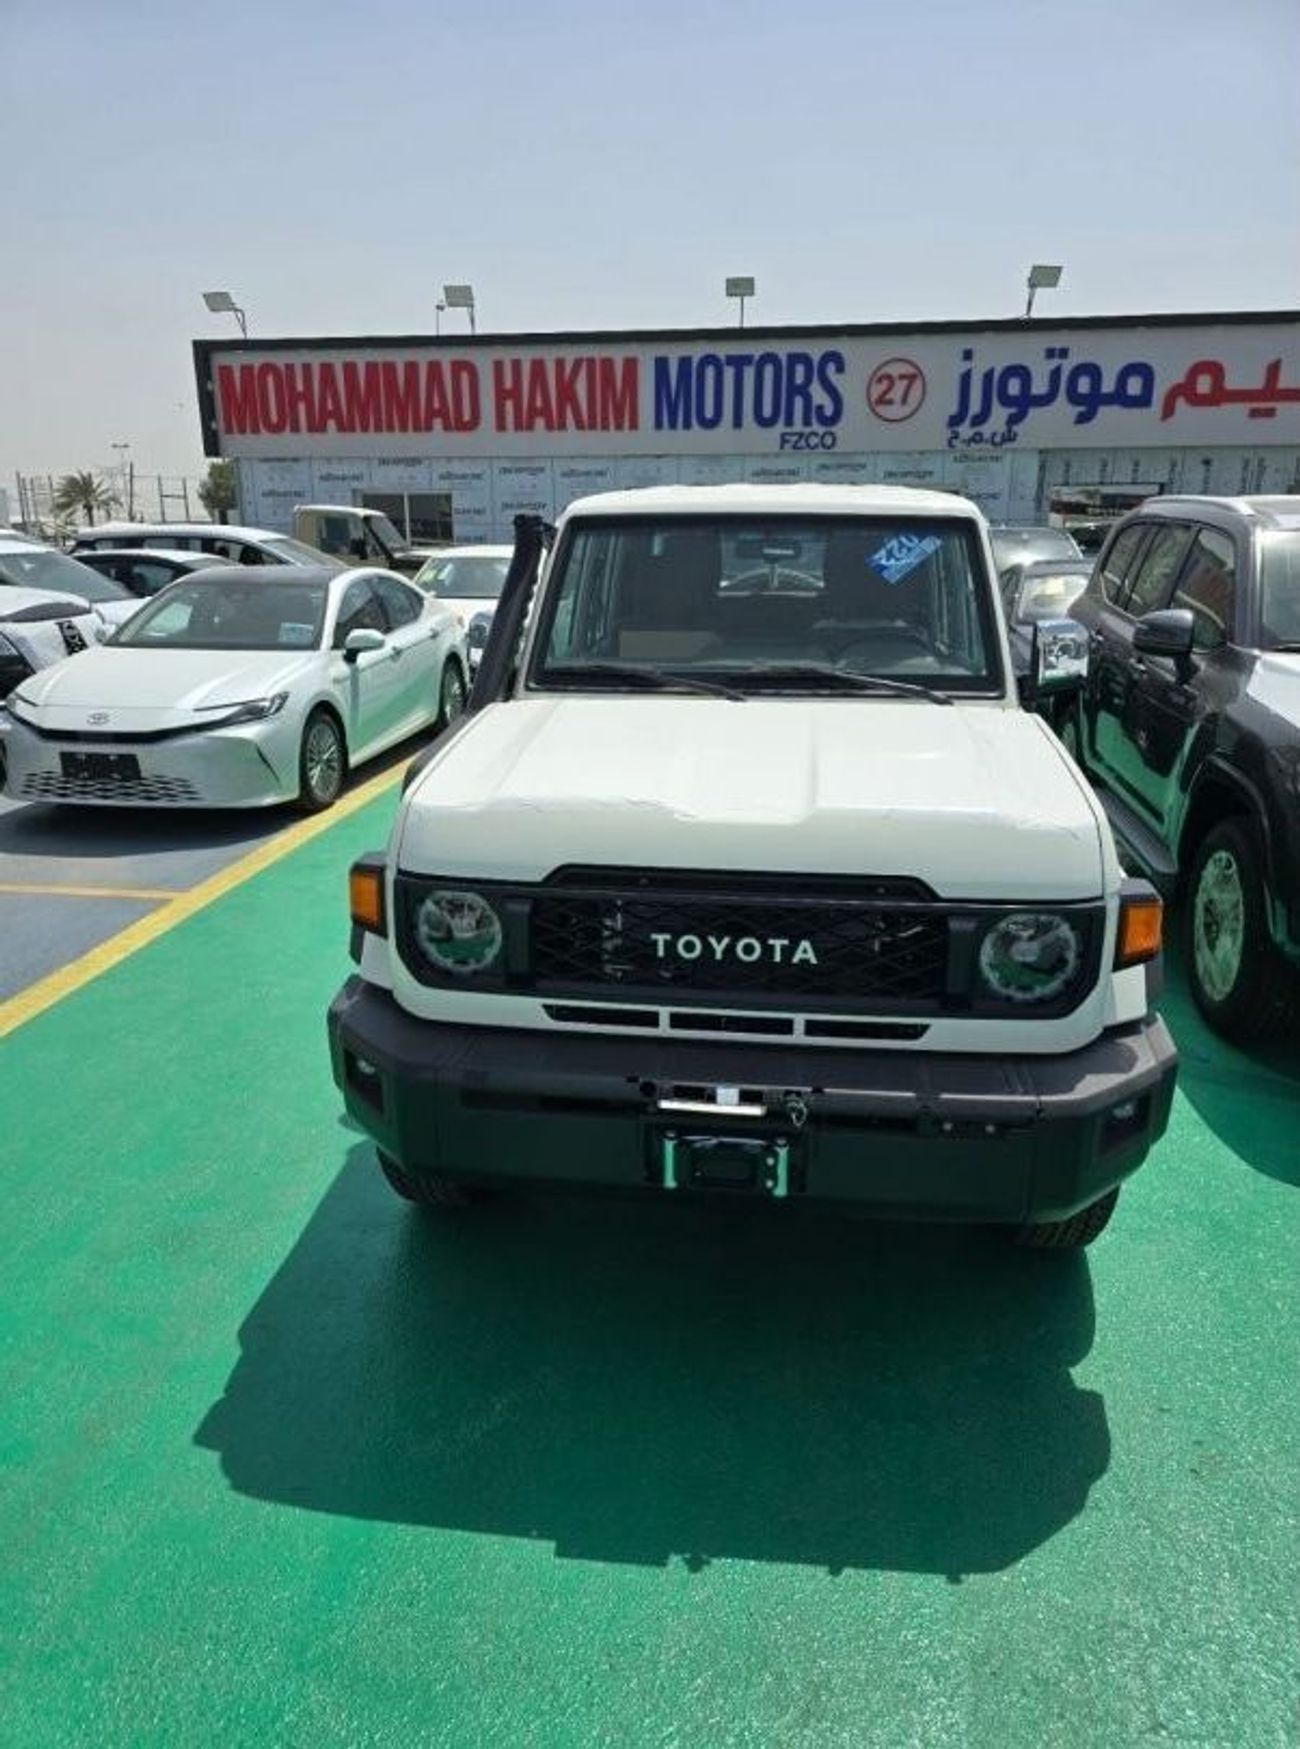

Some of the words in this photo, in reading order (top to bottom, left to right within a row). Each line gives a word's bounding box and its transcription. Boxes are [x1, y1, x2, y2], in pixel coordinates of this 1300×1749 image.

[216, 359, 481, 435] MOHAMMAD
[492, 357, 639, 431] HAKIM
[652, 350, 845, 430] MOTORS
[874, 373, 918, 406] 27
[946, 347, 1155, 428] موتورز
[1160, 358, 1300, 422] يم
[779, 431, 837, 451] FZCO
[650, 933, 818, 965] TOYOTA
